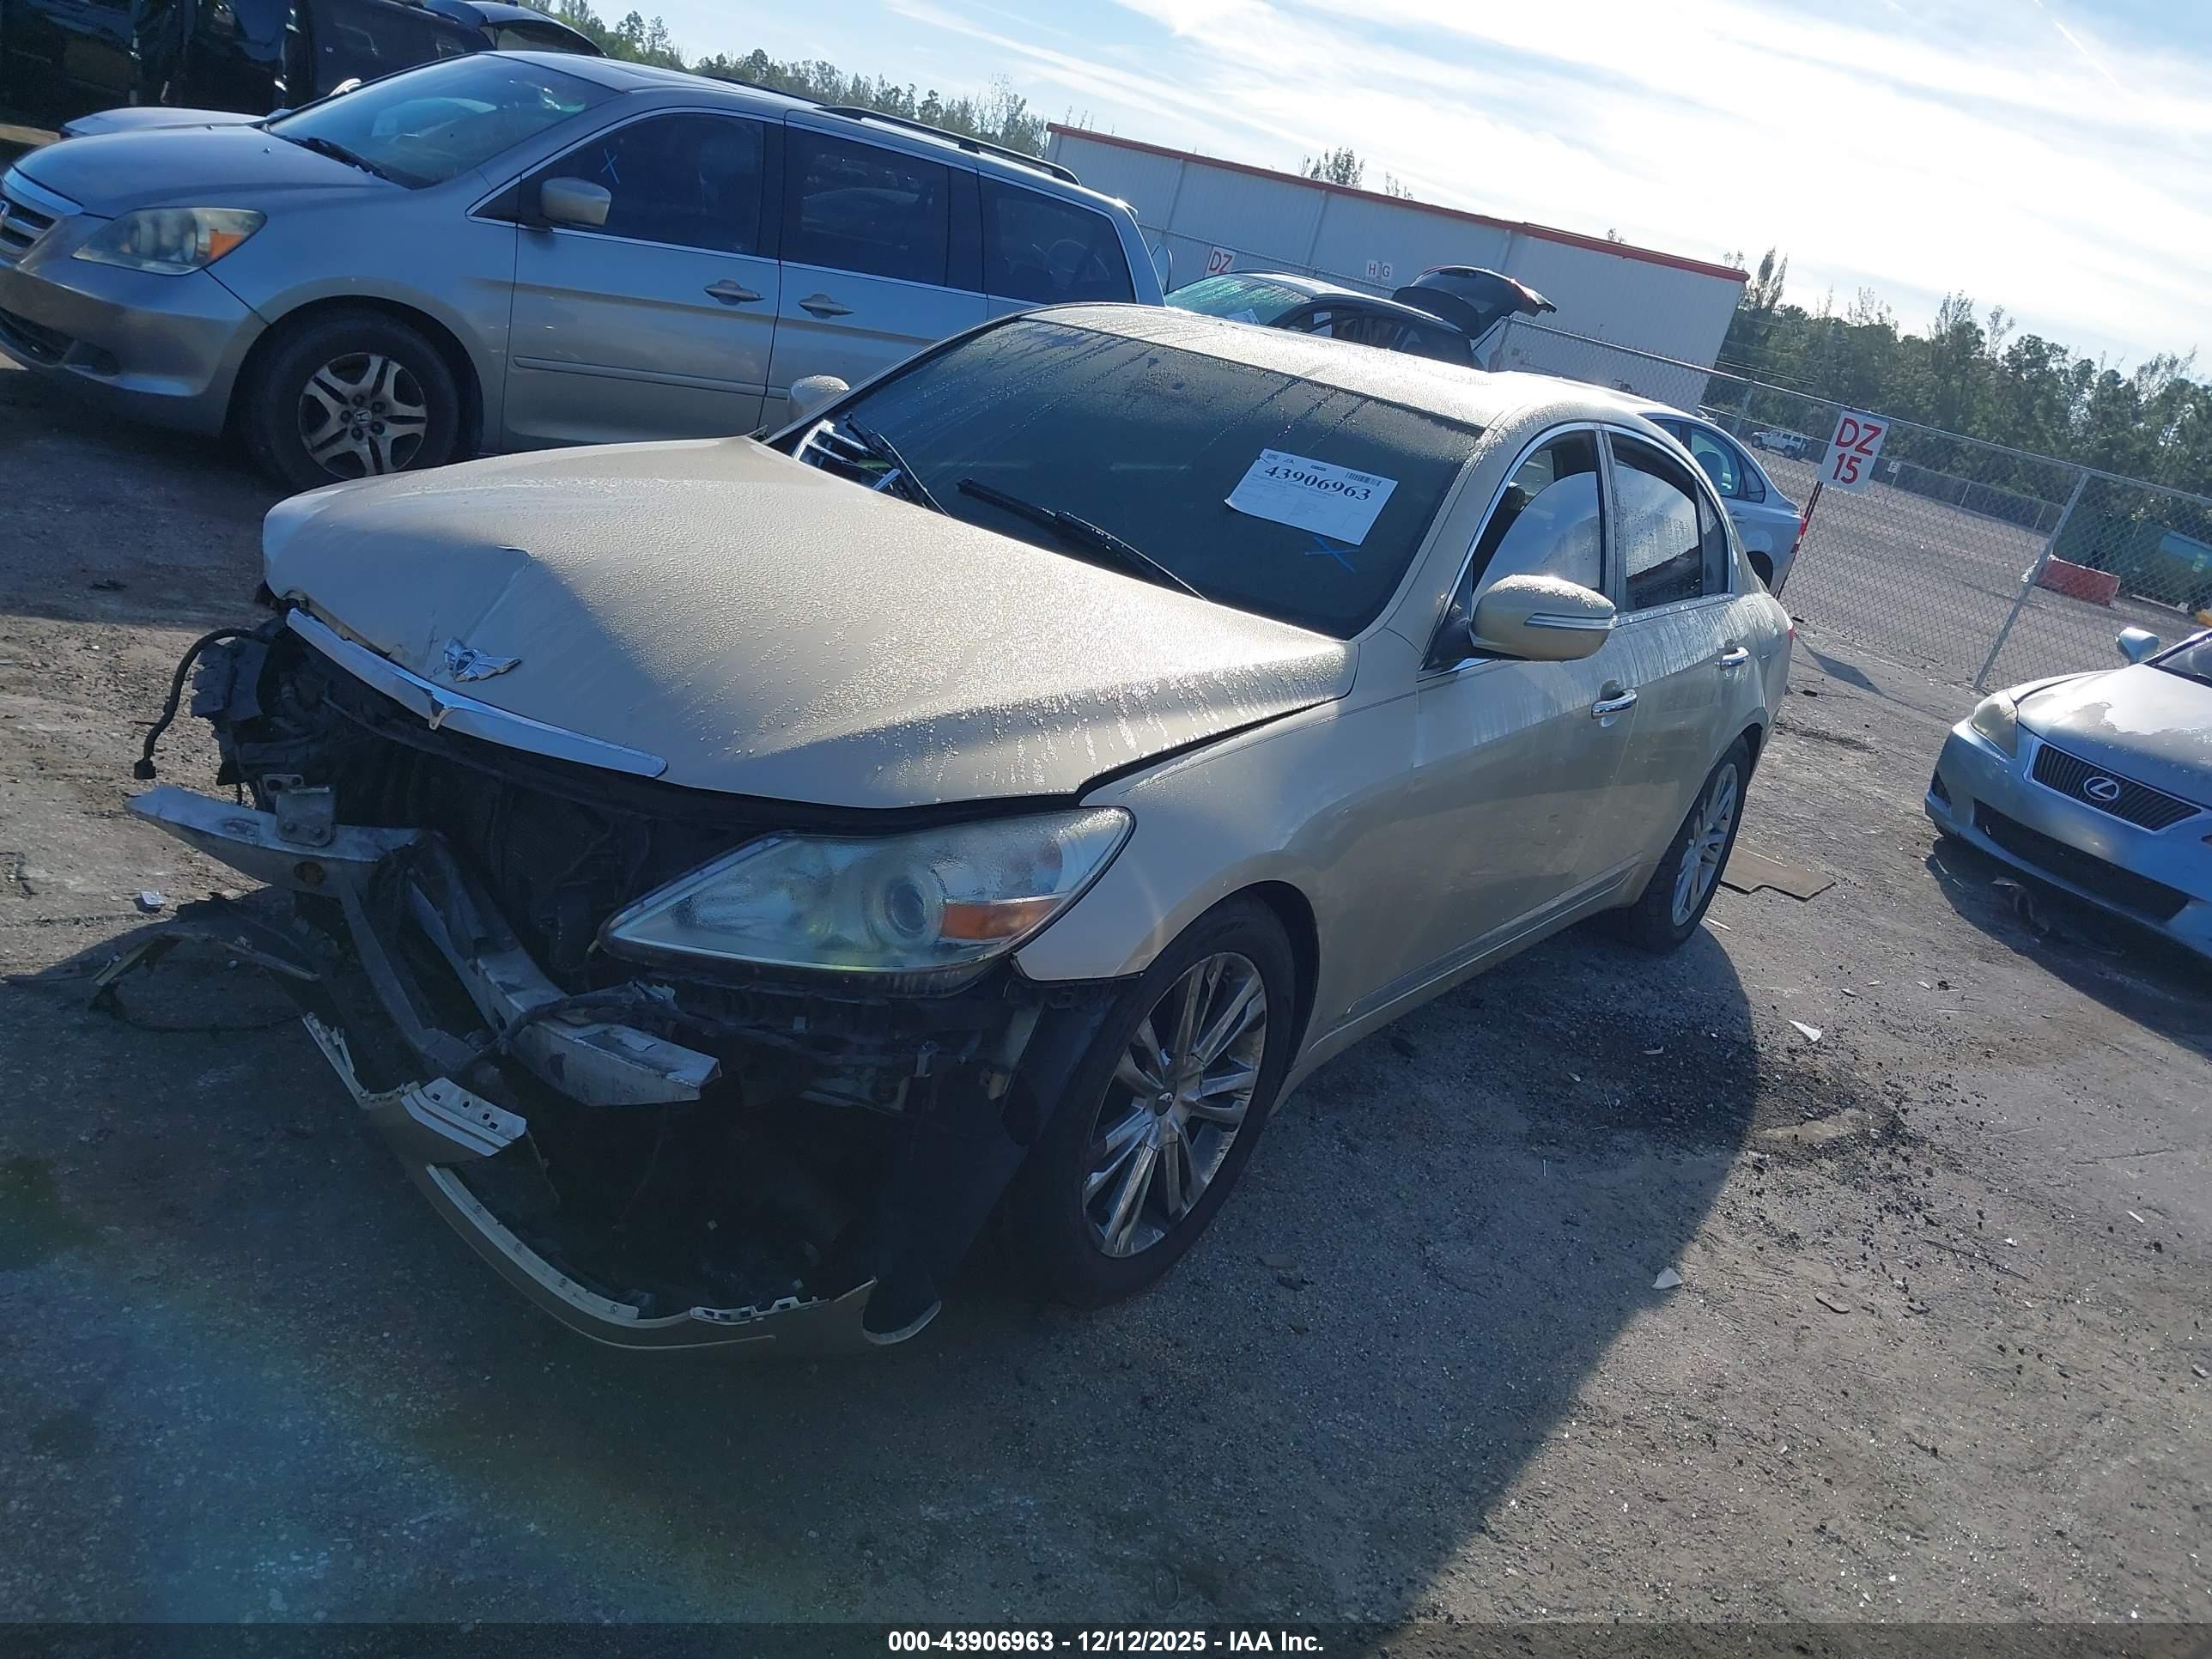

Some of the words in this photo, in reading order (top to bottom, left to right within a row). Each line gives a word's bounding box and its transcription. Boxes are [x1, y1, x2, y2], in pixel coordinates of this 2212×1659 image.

[1209, 251, 1233, 274] DZ
[1835, 417, 1883, 456] DZ
[1264, 465, 1371, 501] 43906963
[1832, 453, 1863, 484] 15
